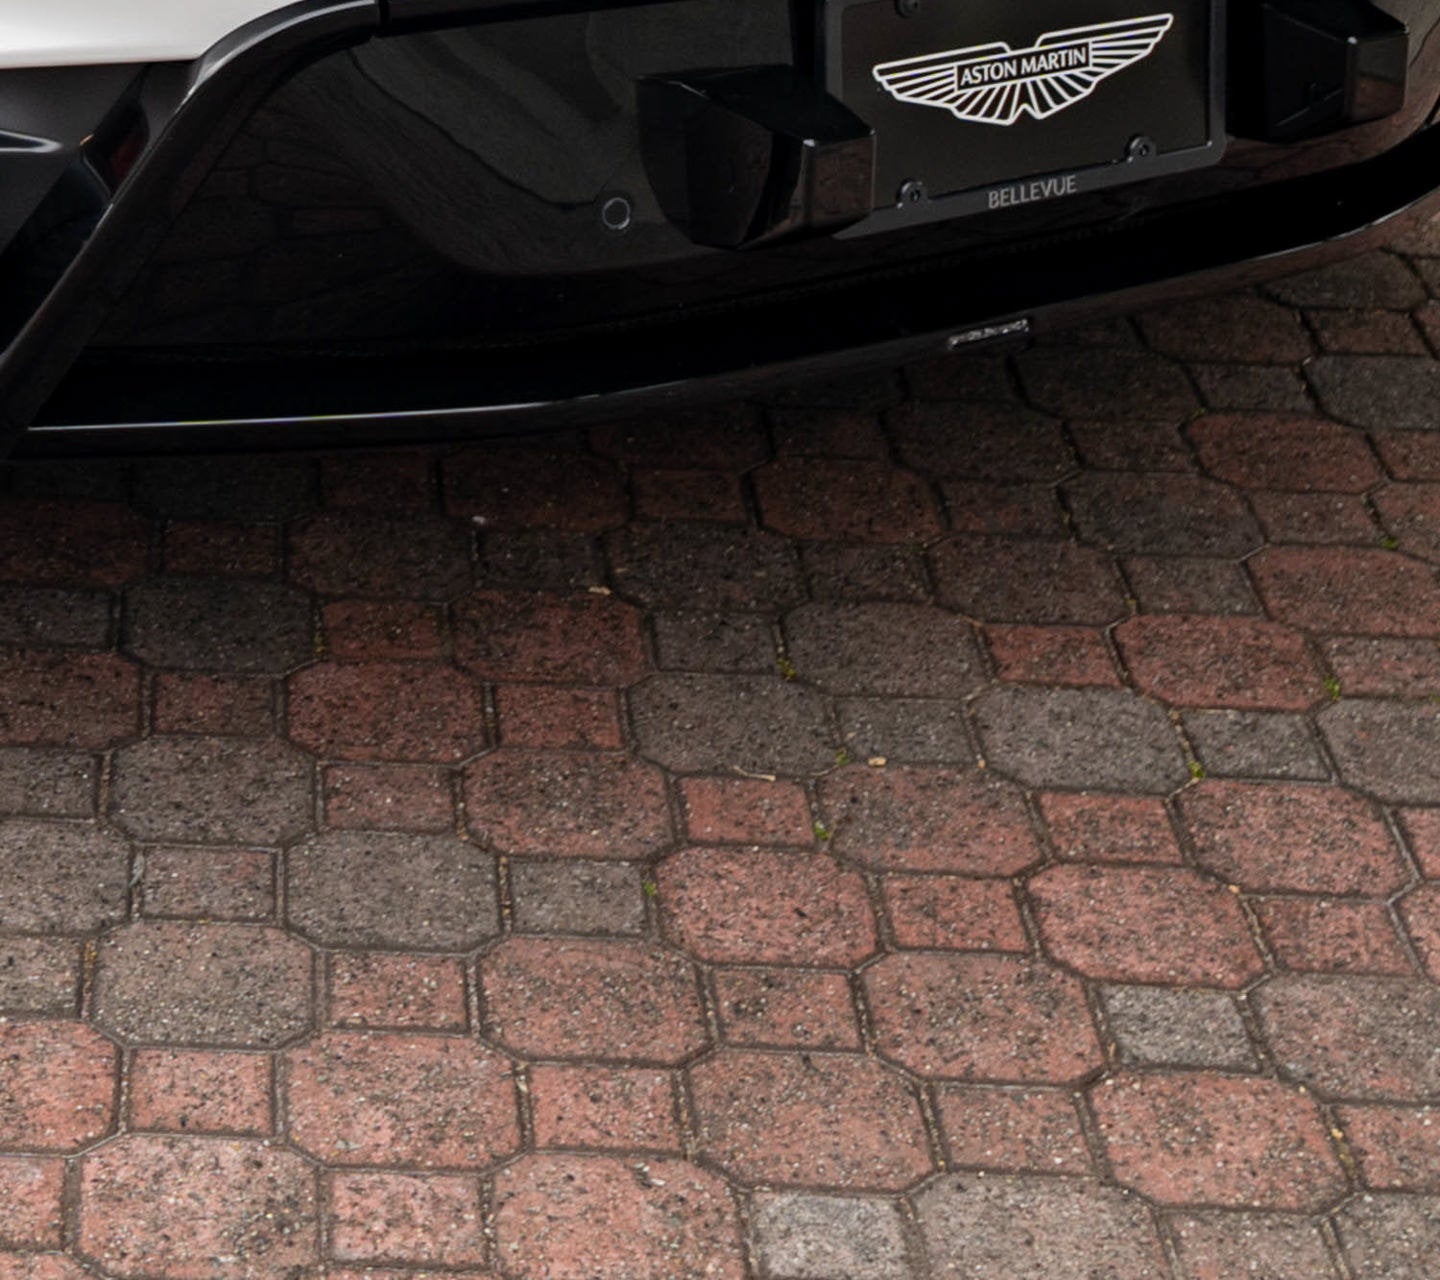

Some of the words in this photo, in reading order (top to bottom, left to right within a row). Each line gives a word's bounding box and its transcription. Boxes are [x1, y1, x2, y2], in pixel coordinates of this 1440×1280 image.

[960, 58, 1018, 87] ASTON
[1020, 46, 1088, 75] MARTIN
[987, 175, 1078, 210] BELLEVUE
